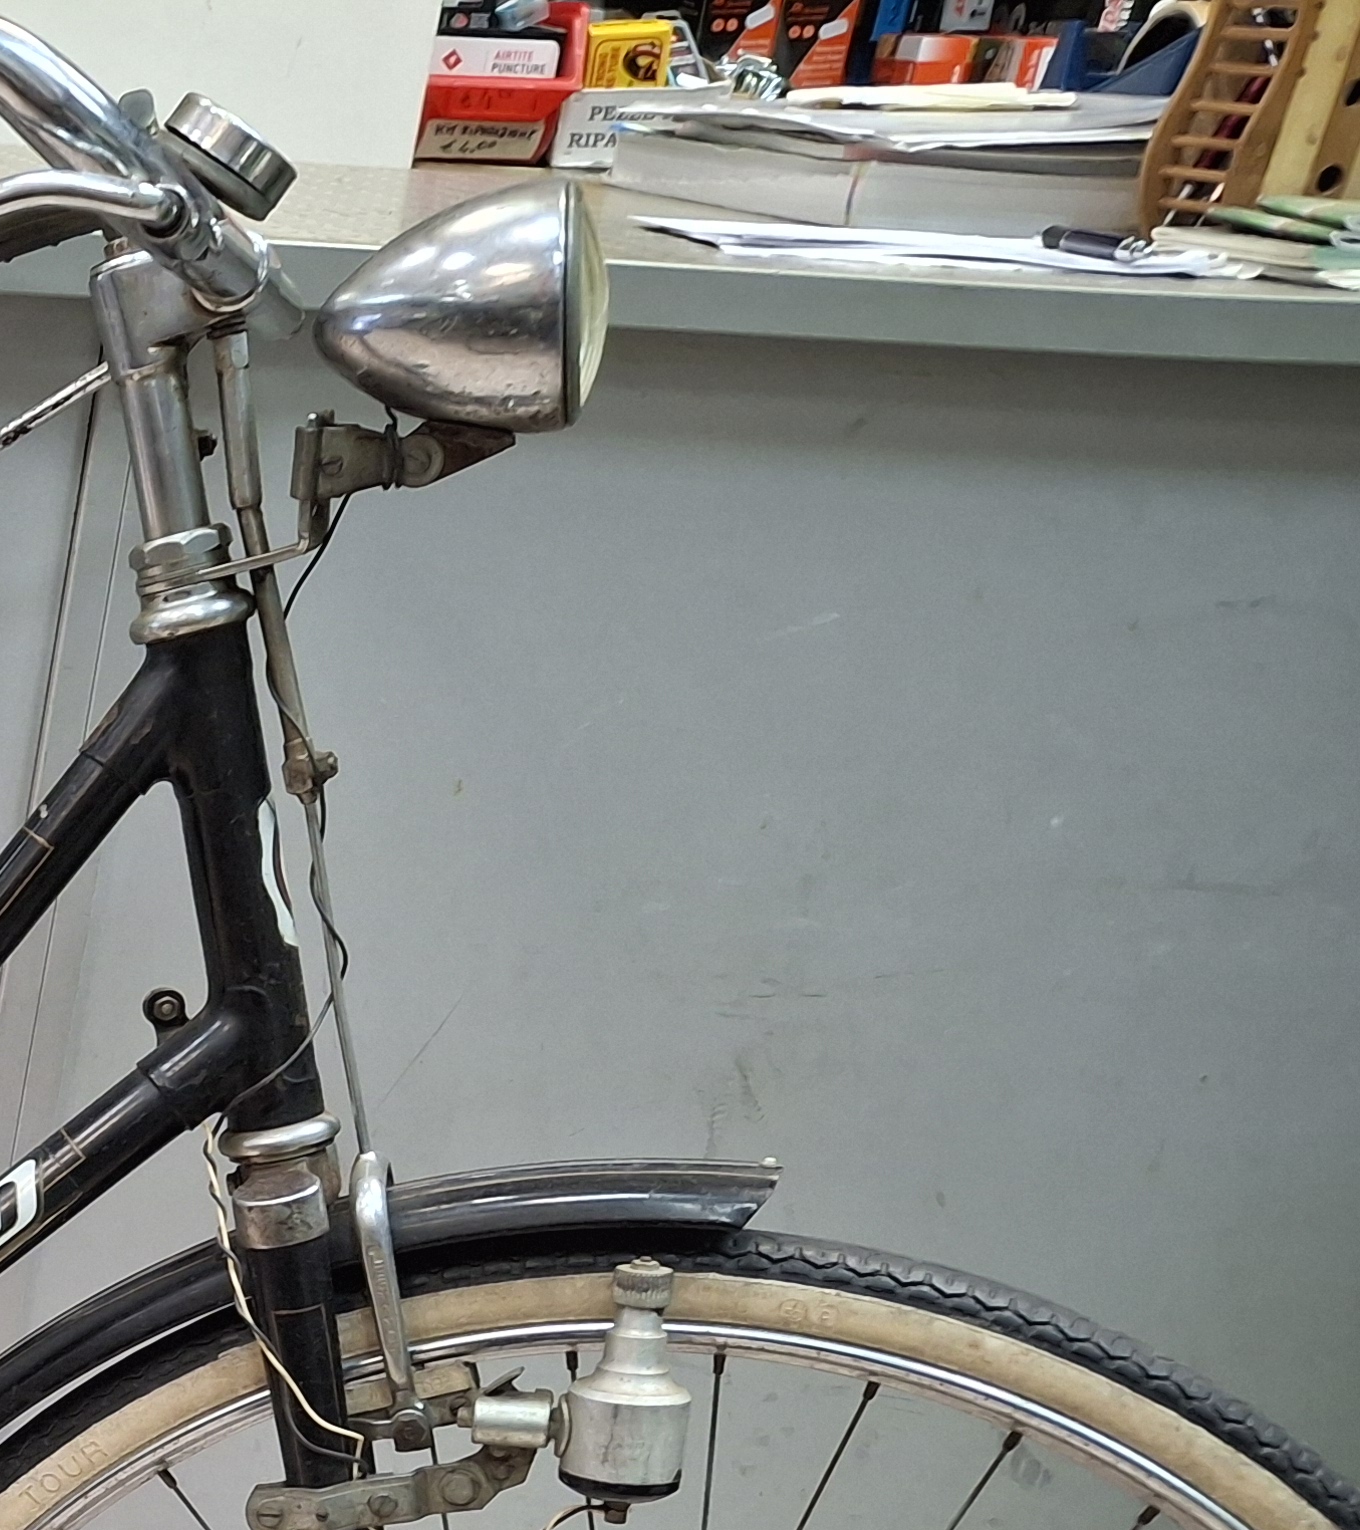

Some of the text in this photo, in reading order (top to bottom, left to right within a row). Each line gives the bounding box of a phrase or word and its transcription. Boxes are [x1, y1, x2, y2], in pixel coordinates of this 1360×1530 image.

[494, 50, 534, 62] AIRTITE
[491, 62, 547, 75] PUNCTURE
[19, 1440, 109, 1508] TOUR
